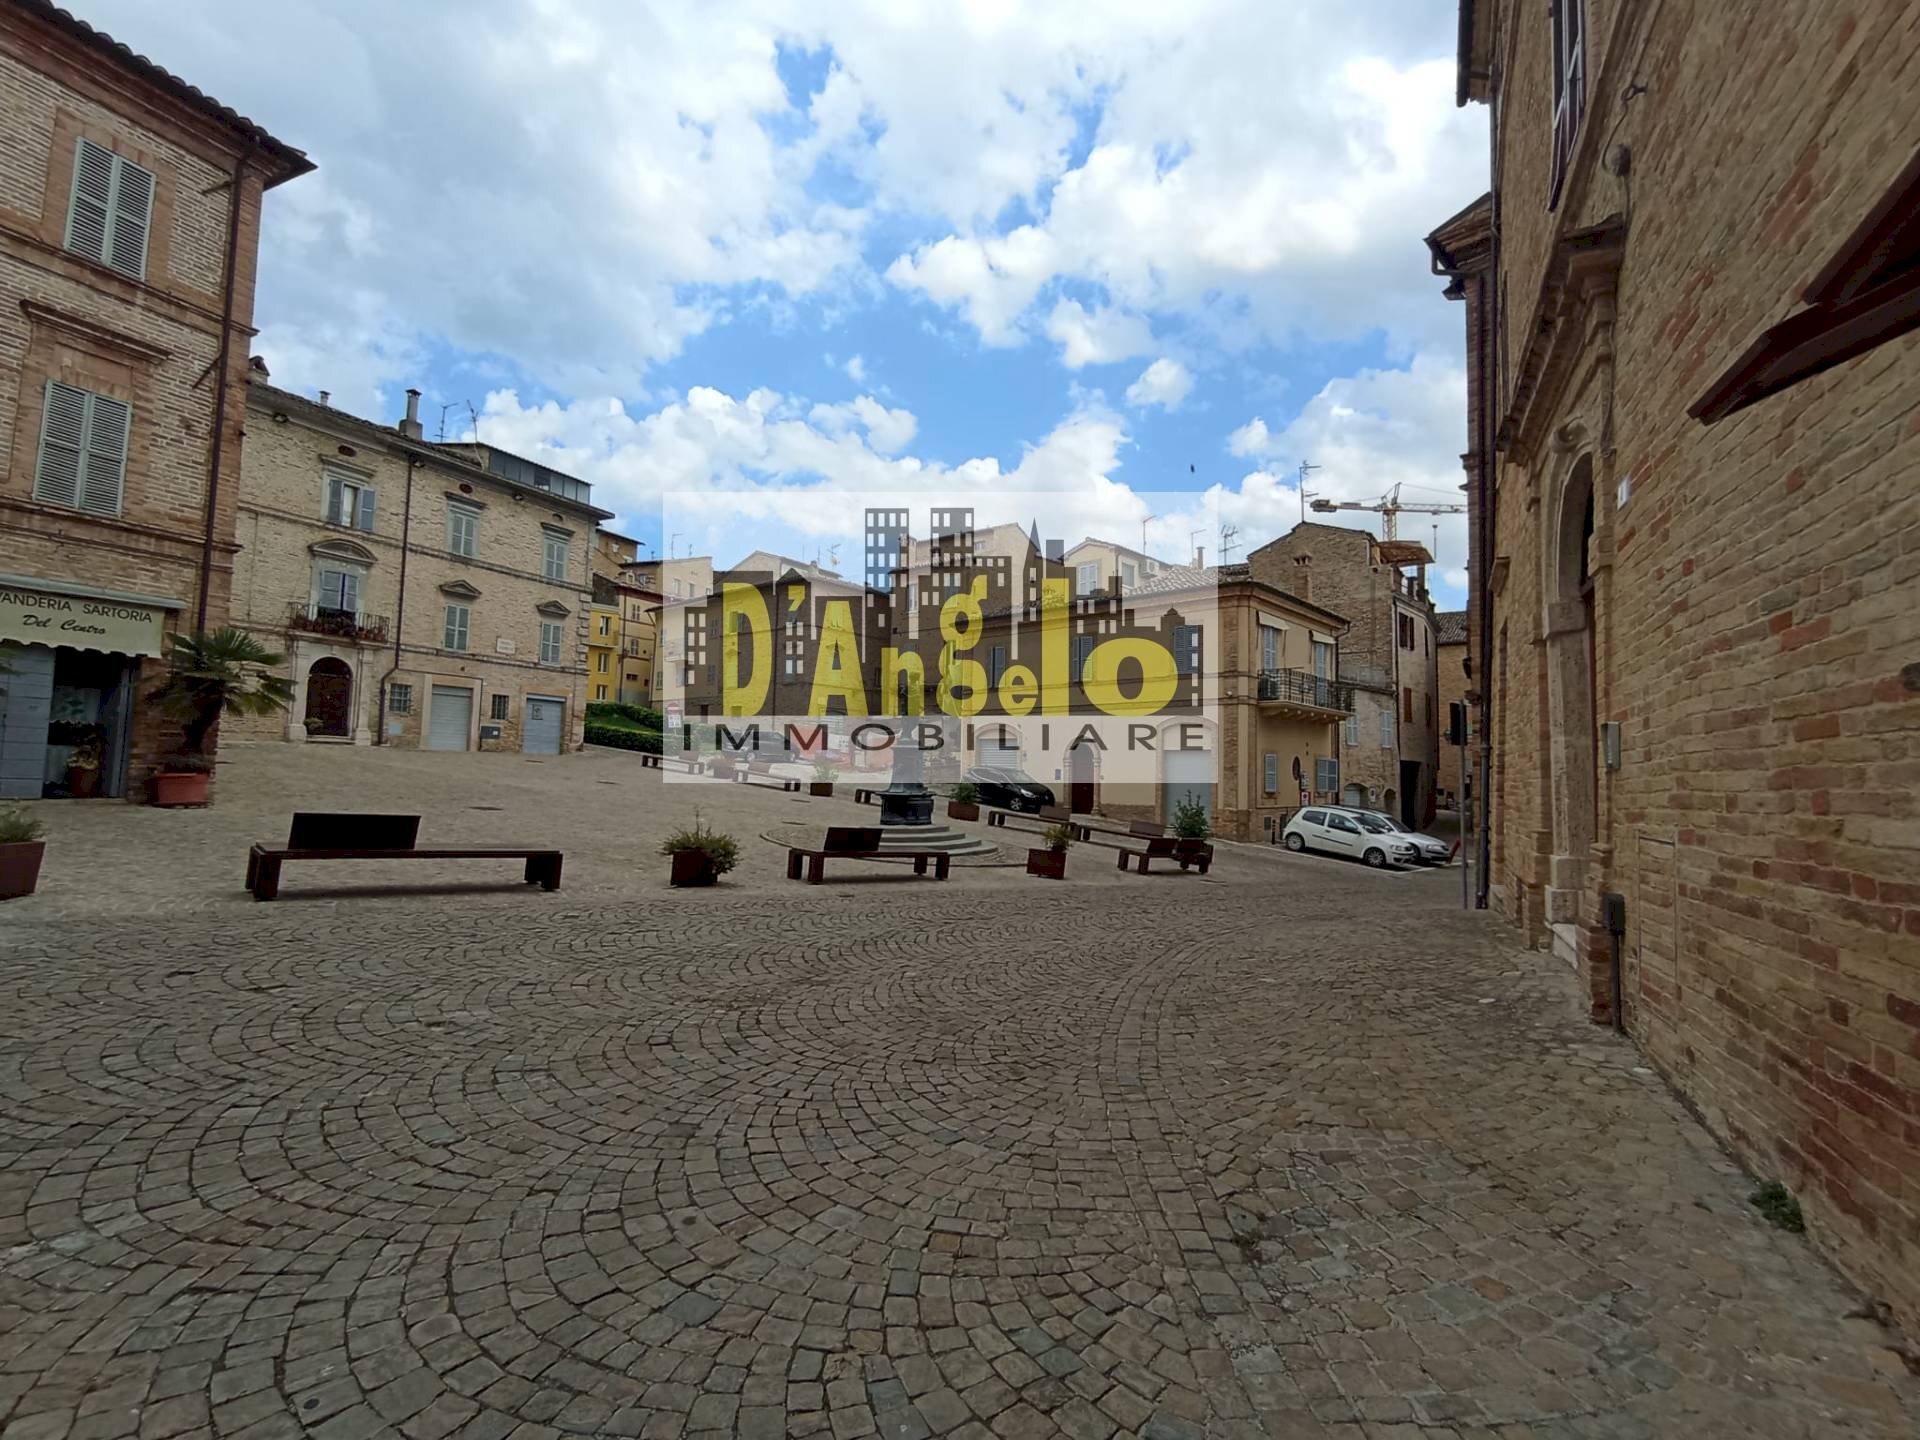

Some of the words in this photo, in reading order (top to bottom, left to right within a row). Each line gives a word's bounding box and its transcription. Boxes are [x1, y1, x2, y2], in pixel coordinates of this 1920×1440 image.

[82, 603, 152, 623] SARTORIA
[23, 614, 52, 627] Del
[60, 619, 106, 634] Centro
